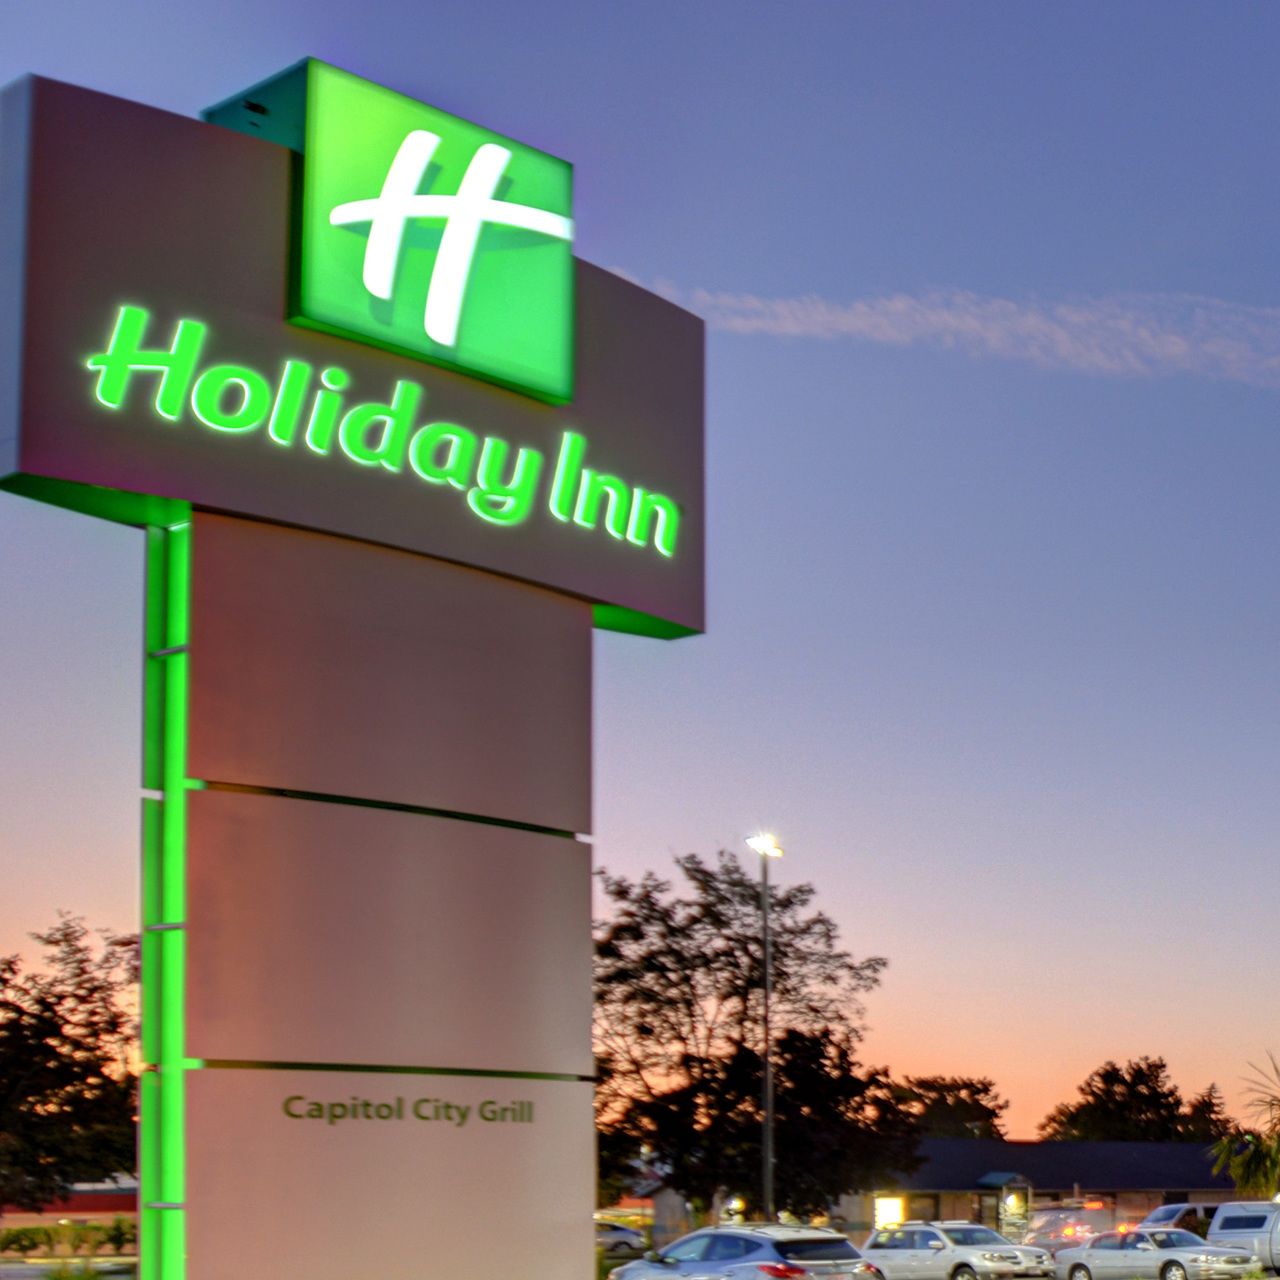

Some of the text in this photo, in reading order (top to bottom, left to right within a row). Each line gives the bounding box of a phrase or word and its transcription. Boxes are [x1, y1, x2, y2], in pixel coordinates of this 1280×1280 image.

[85, 304, 682, 558] Holiday Inn
[282, 1094, 535, 1127] Capitol City Grill
